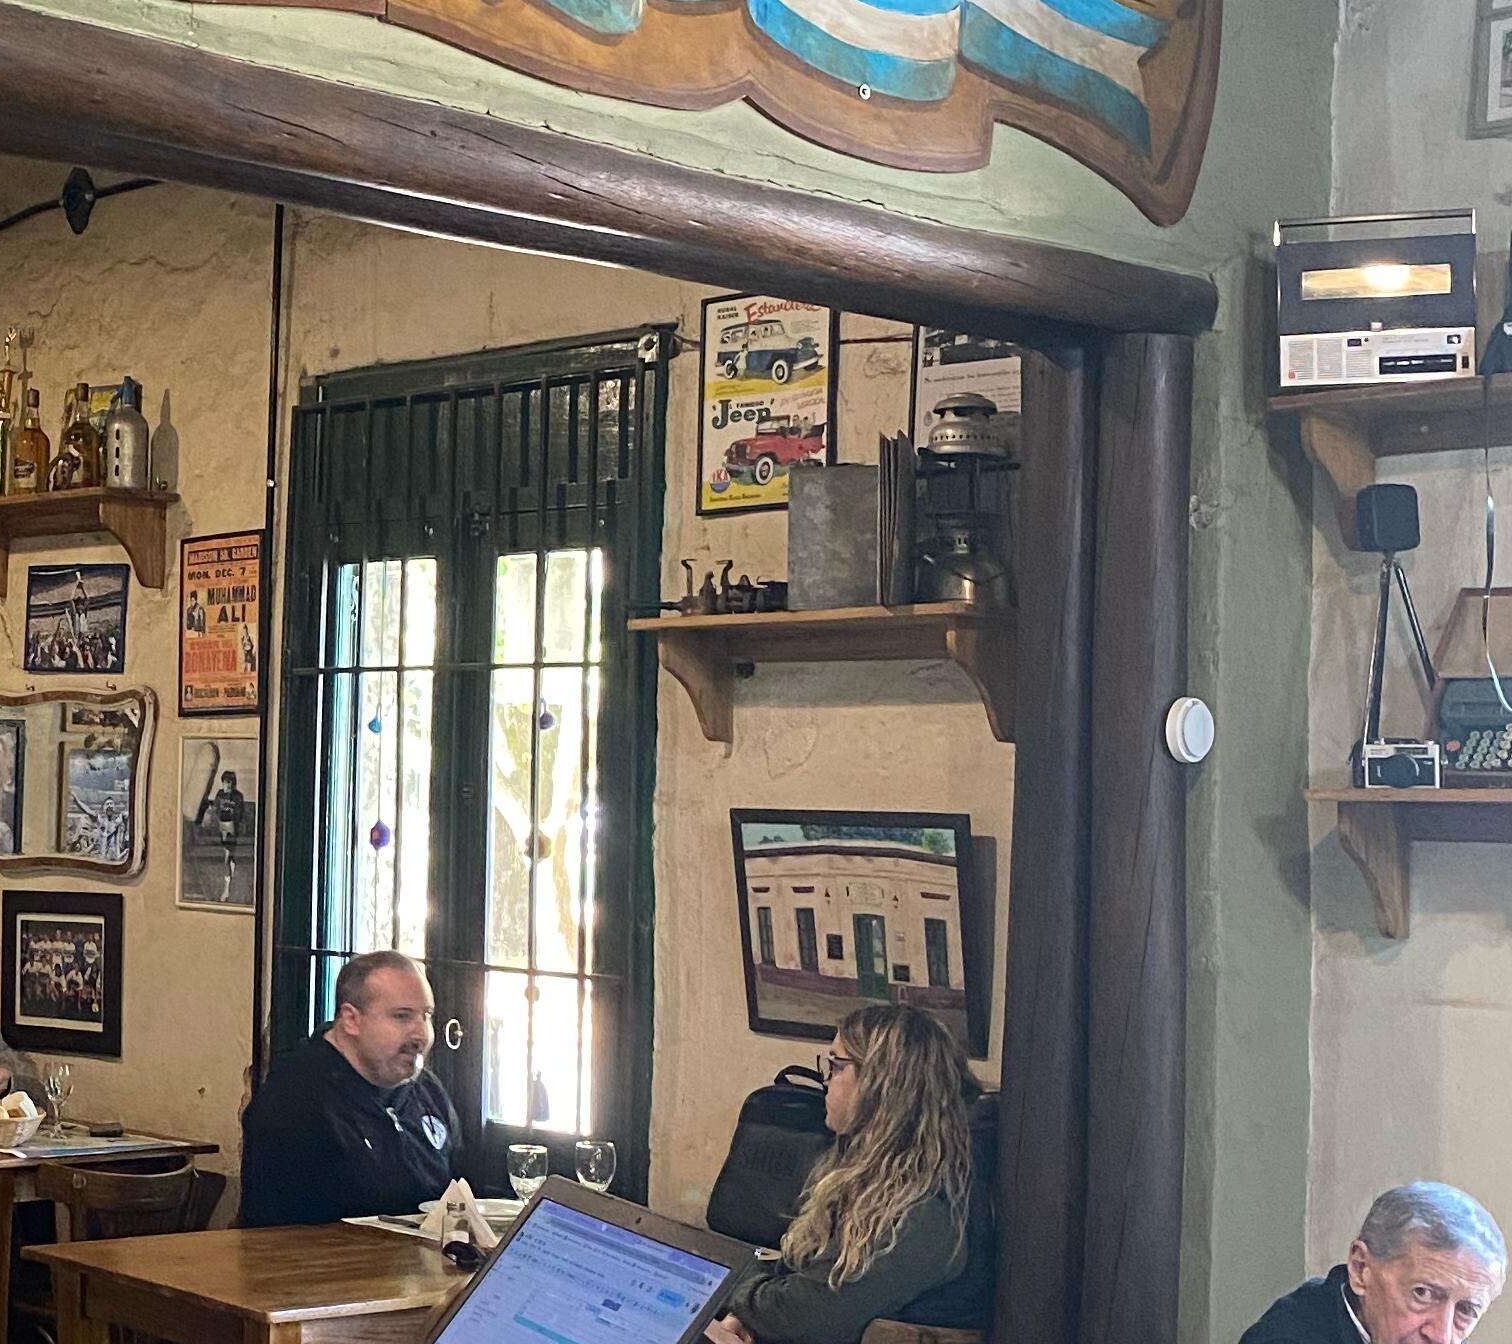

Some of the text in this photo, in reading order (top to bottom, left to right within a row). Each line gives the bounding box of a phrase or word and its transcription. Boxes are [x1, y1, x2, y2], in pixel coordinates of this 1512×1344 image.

[215, 567, 235, 578] DEC.
[239, 566, 247, 577] 7
[207, 584, 257, 606] MUHAMMAD
[217, 603, 247, 624] ALI
